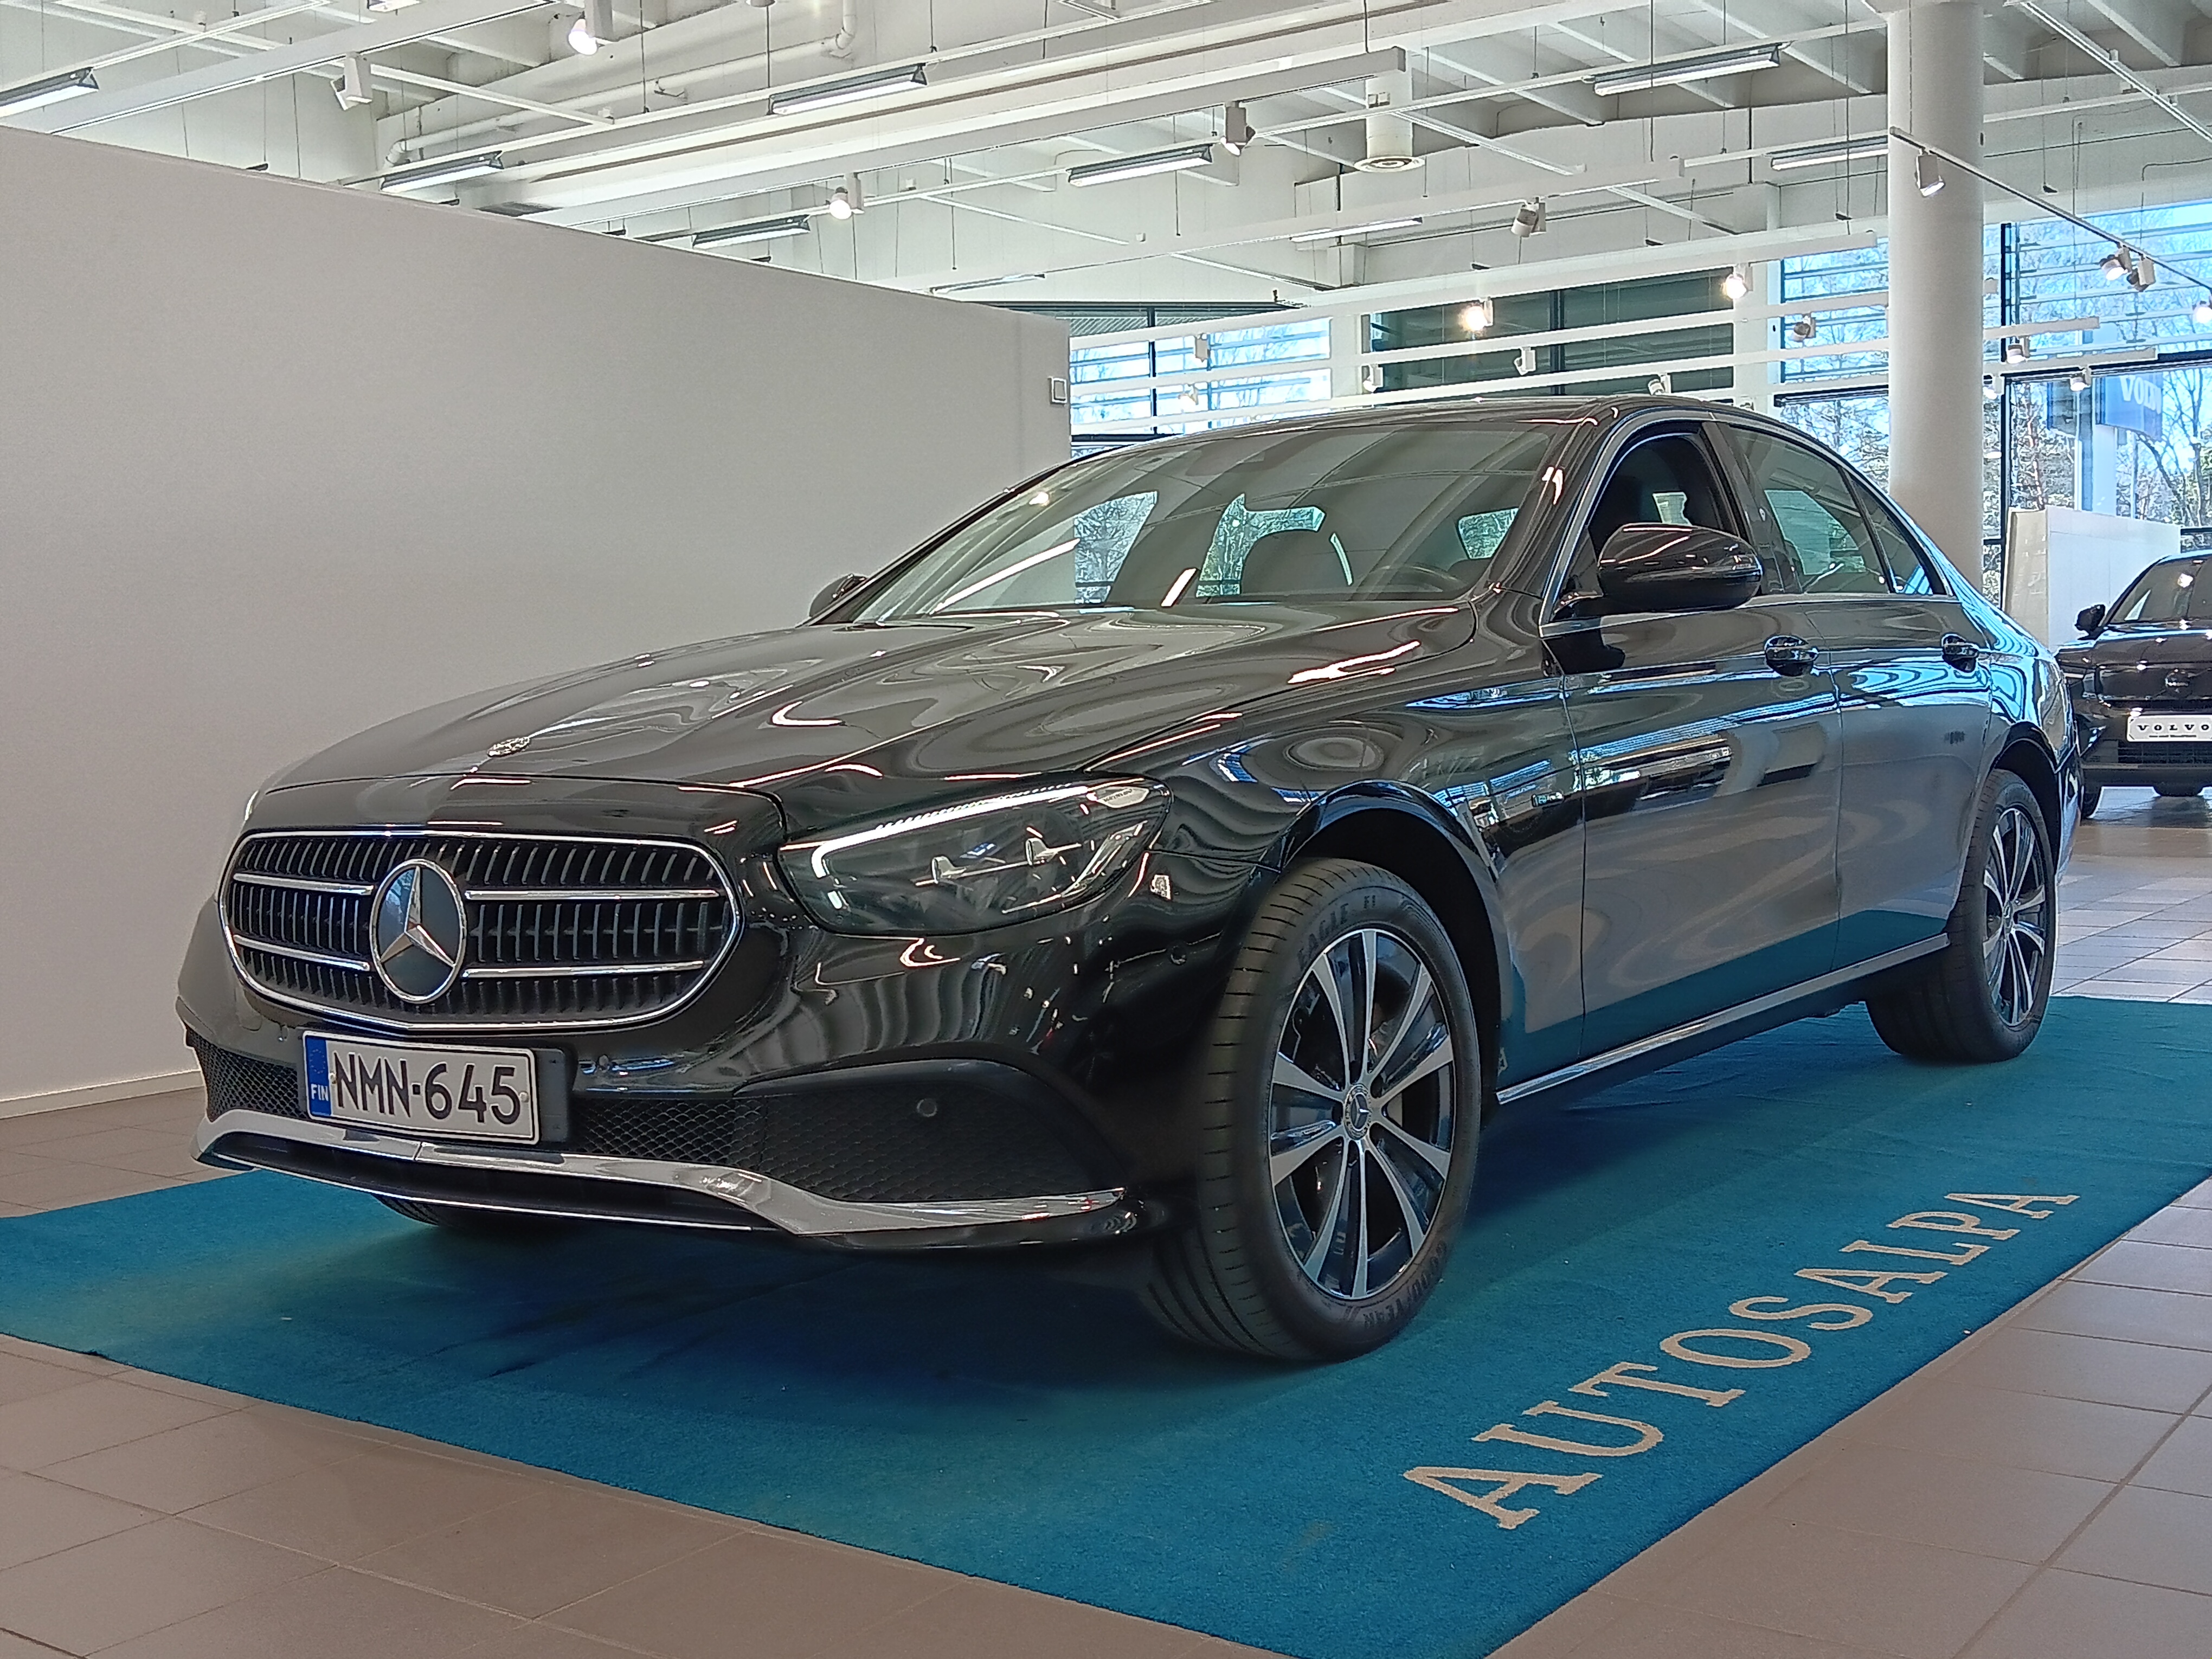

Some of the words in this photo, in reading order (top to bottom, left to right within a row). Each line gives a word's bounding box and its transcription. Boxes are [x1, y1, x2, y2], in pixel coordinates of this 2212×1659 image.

[311, 1084, 329, 1101] FIN
[333, 1052, 520, 1125] NMN-645
[1402, 1192, 2080, 1529] AUTOSALPA
